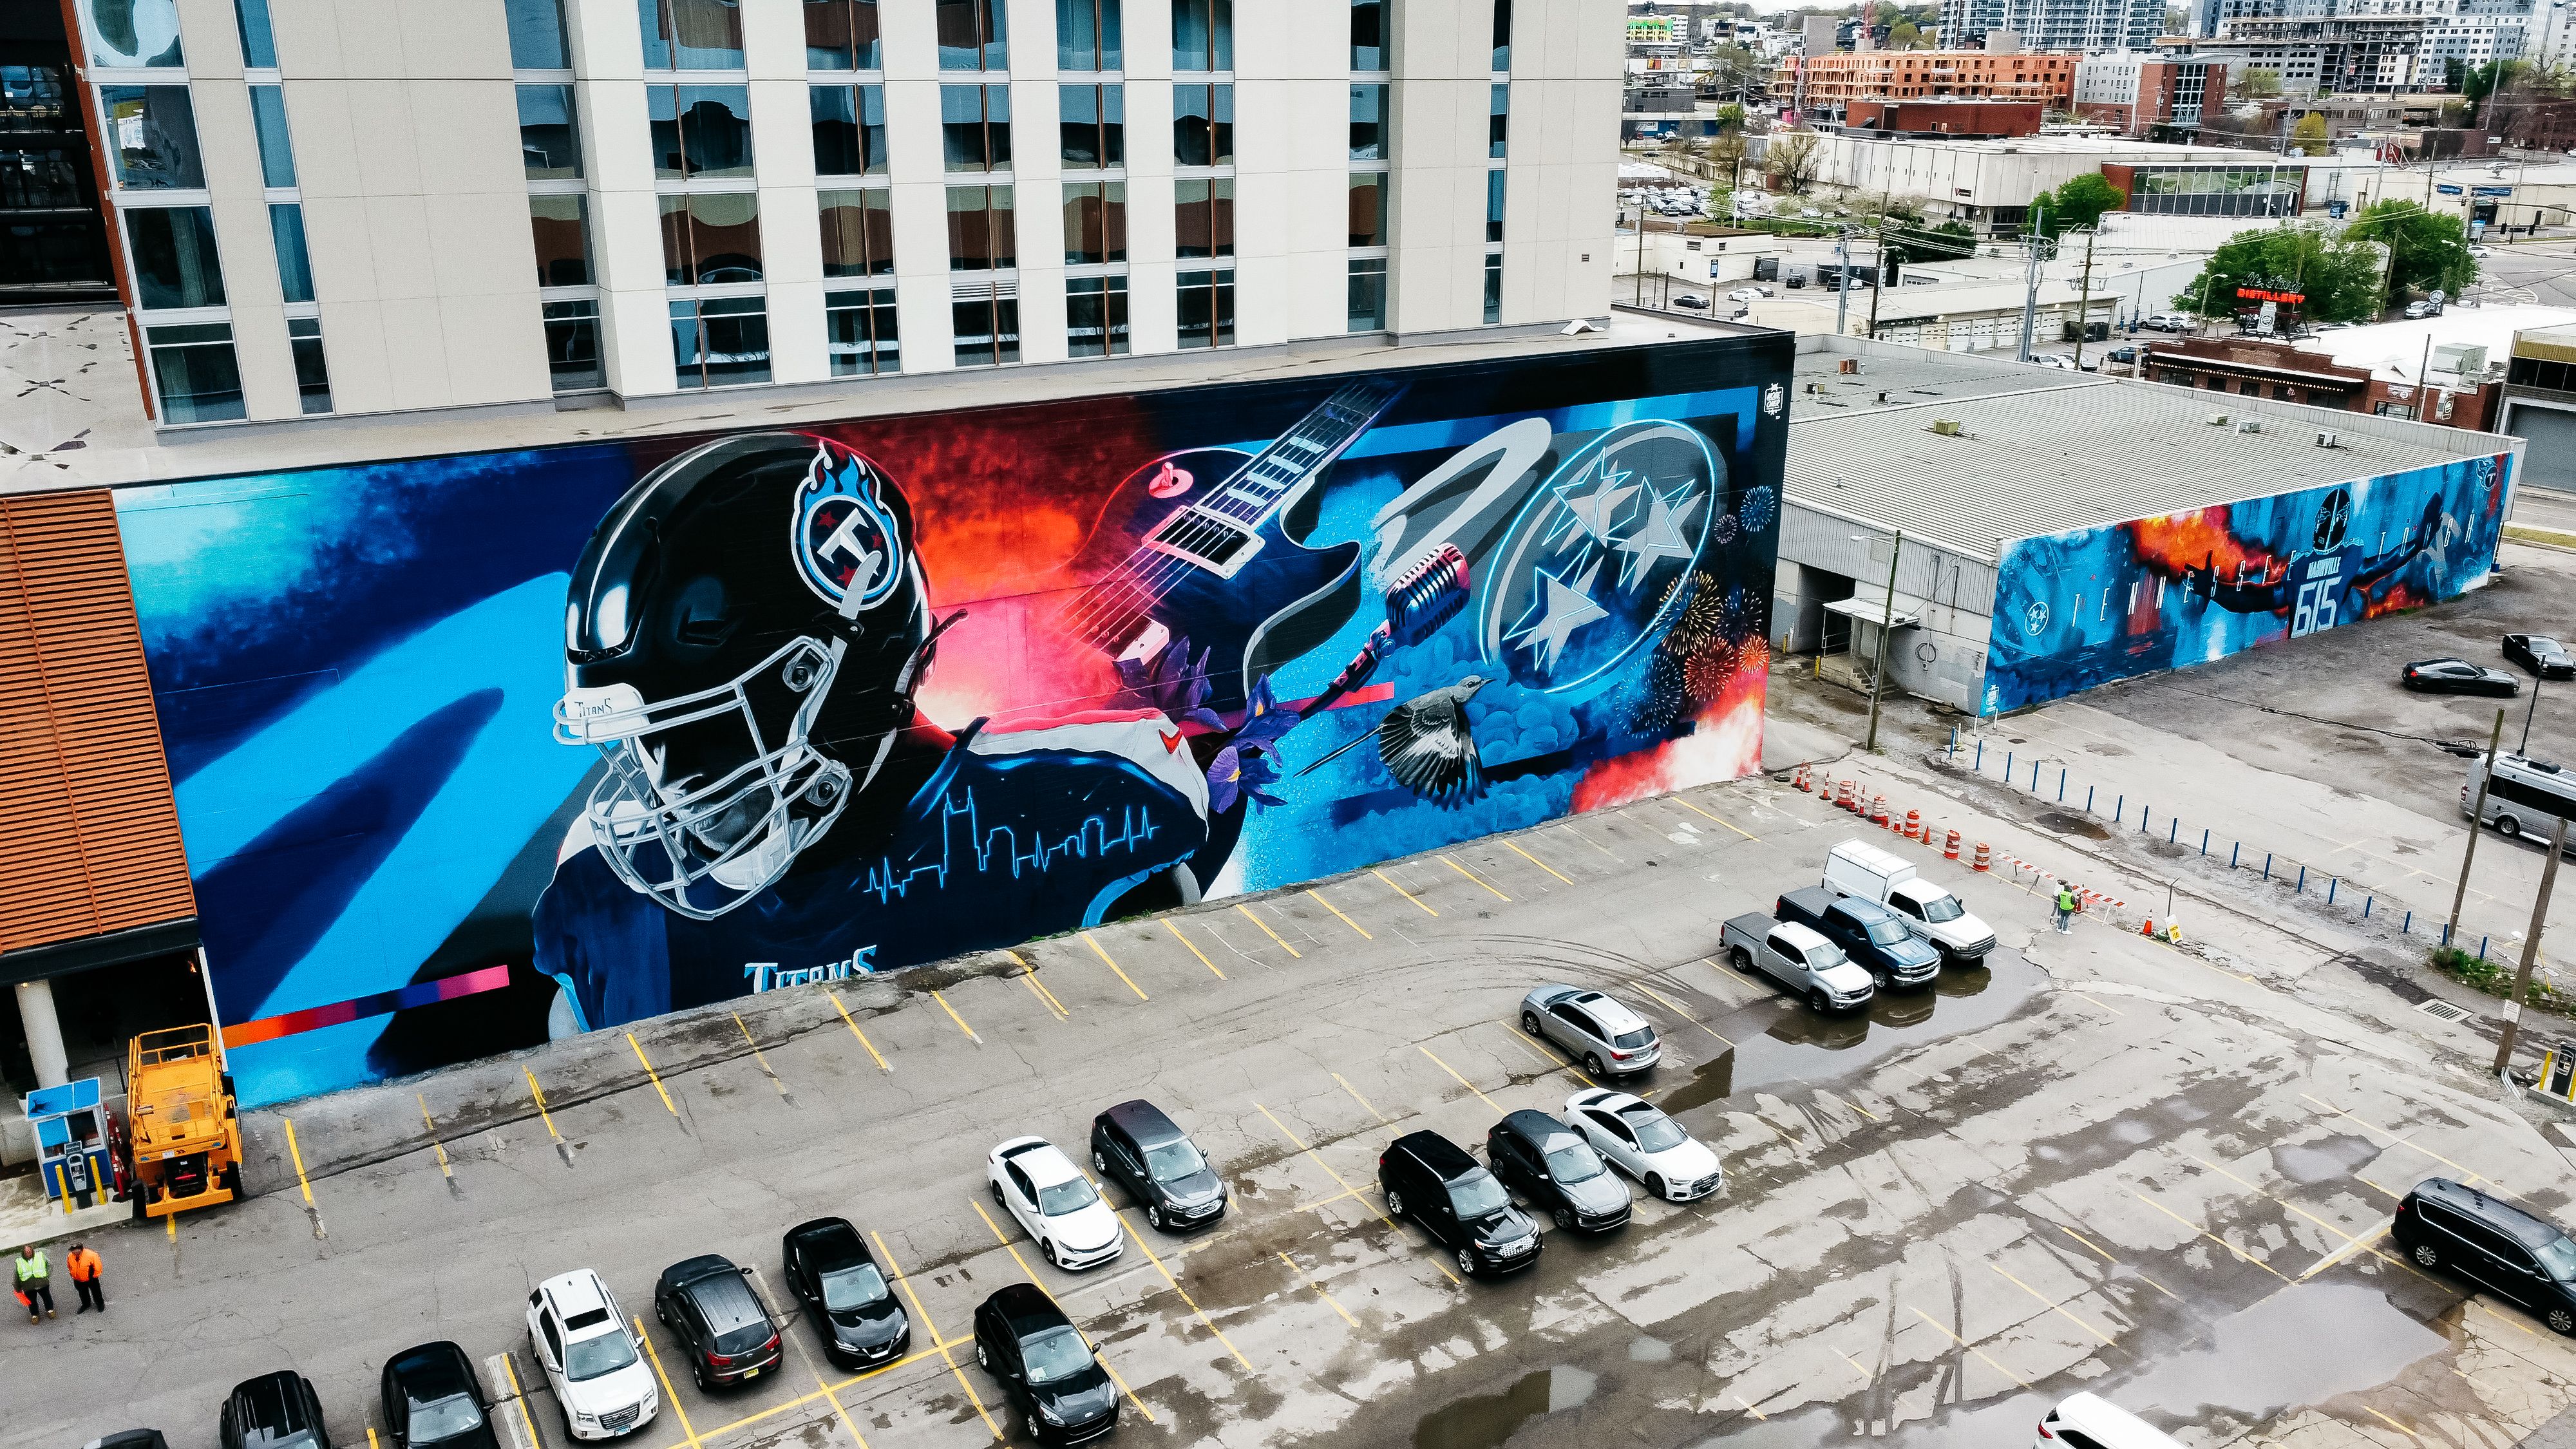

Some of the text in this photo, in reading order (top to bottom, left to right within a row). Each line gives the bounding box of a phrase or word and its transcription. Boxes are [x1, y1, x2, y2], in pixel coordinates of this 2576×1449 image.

[2238, 288, 2306, 303] DISTILLERY
[2072, 514, 2475, 627] TENNESSEE TOUGH
[2291, 576, 2343, 639] 615
[574, 698, 612, 718] TITANS
[744, 944, 877, 994] TITANS
